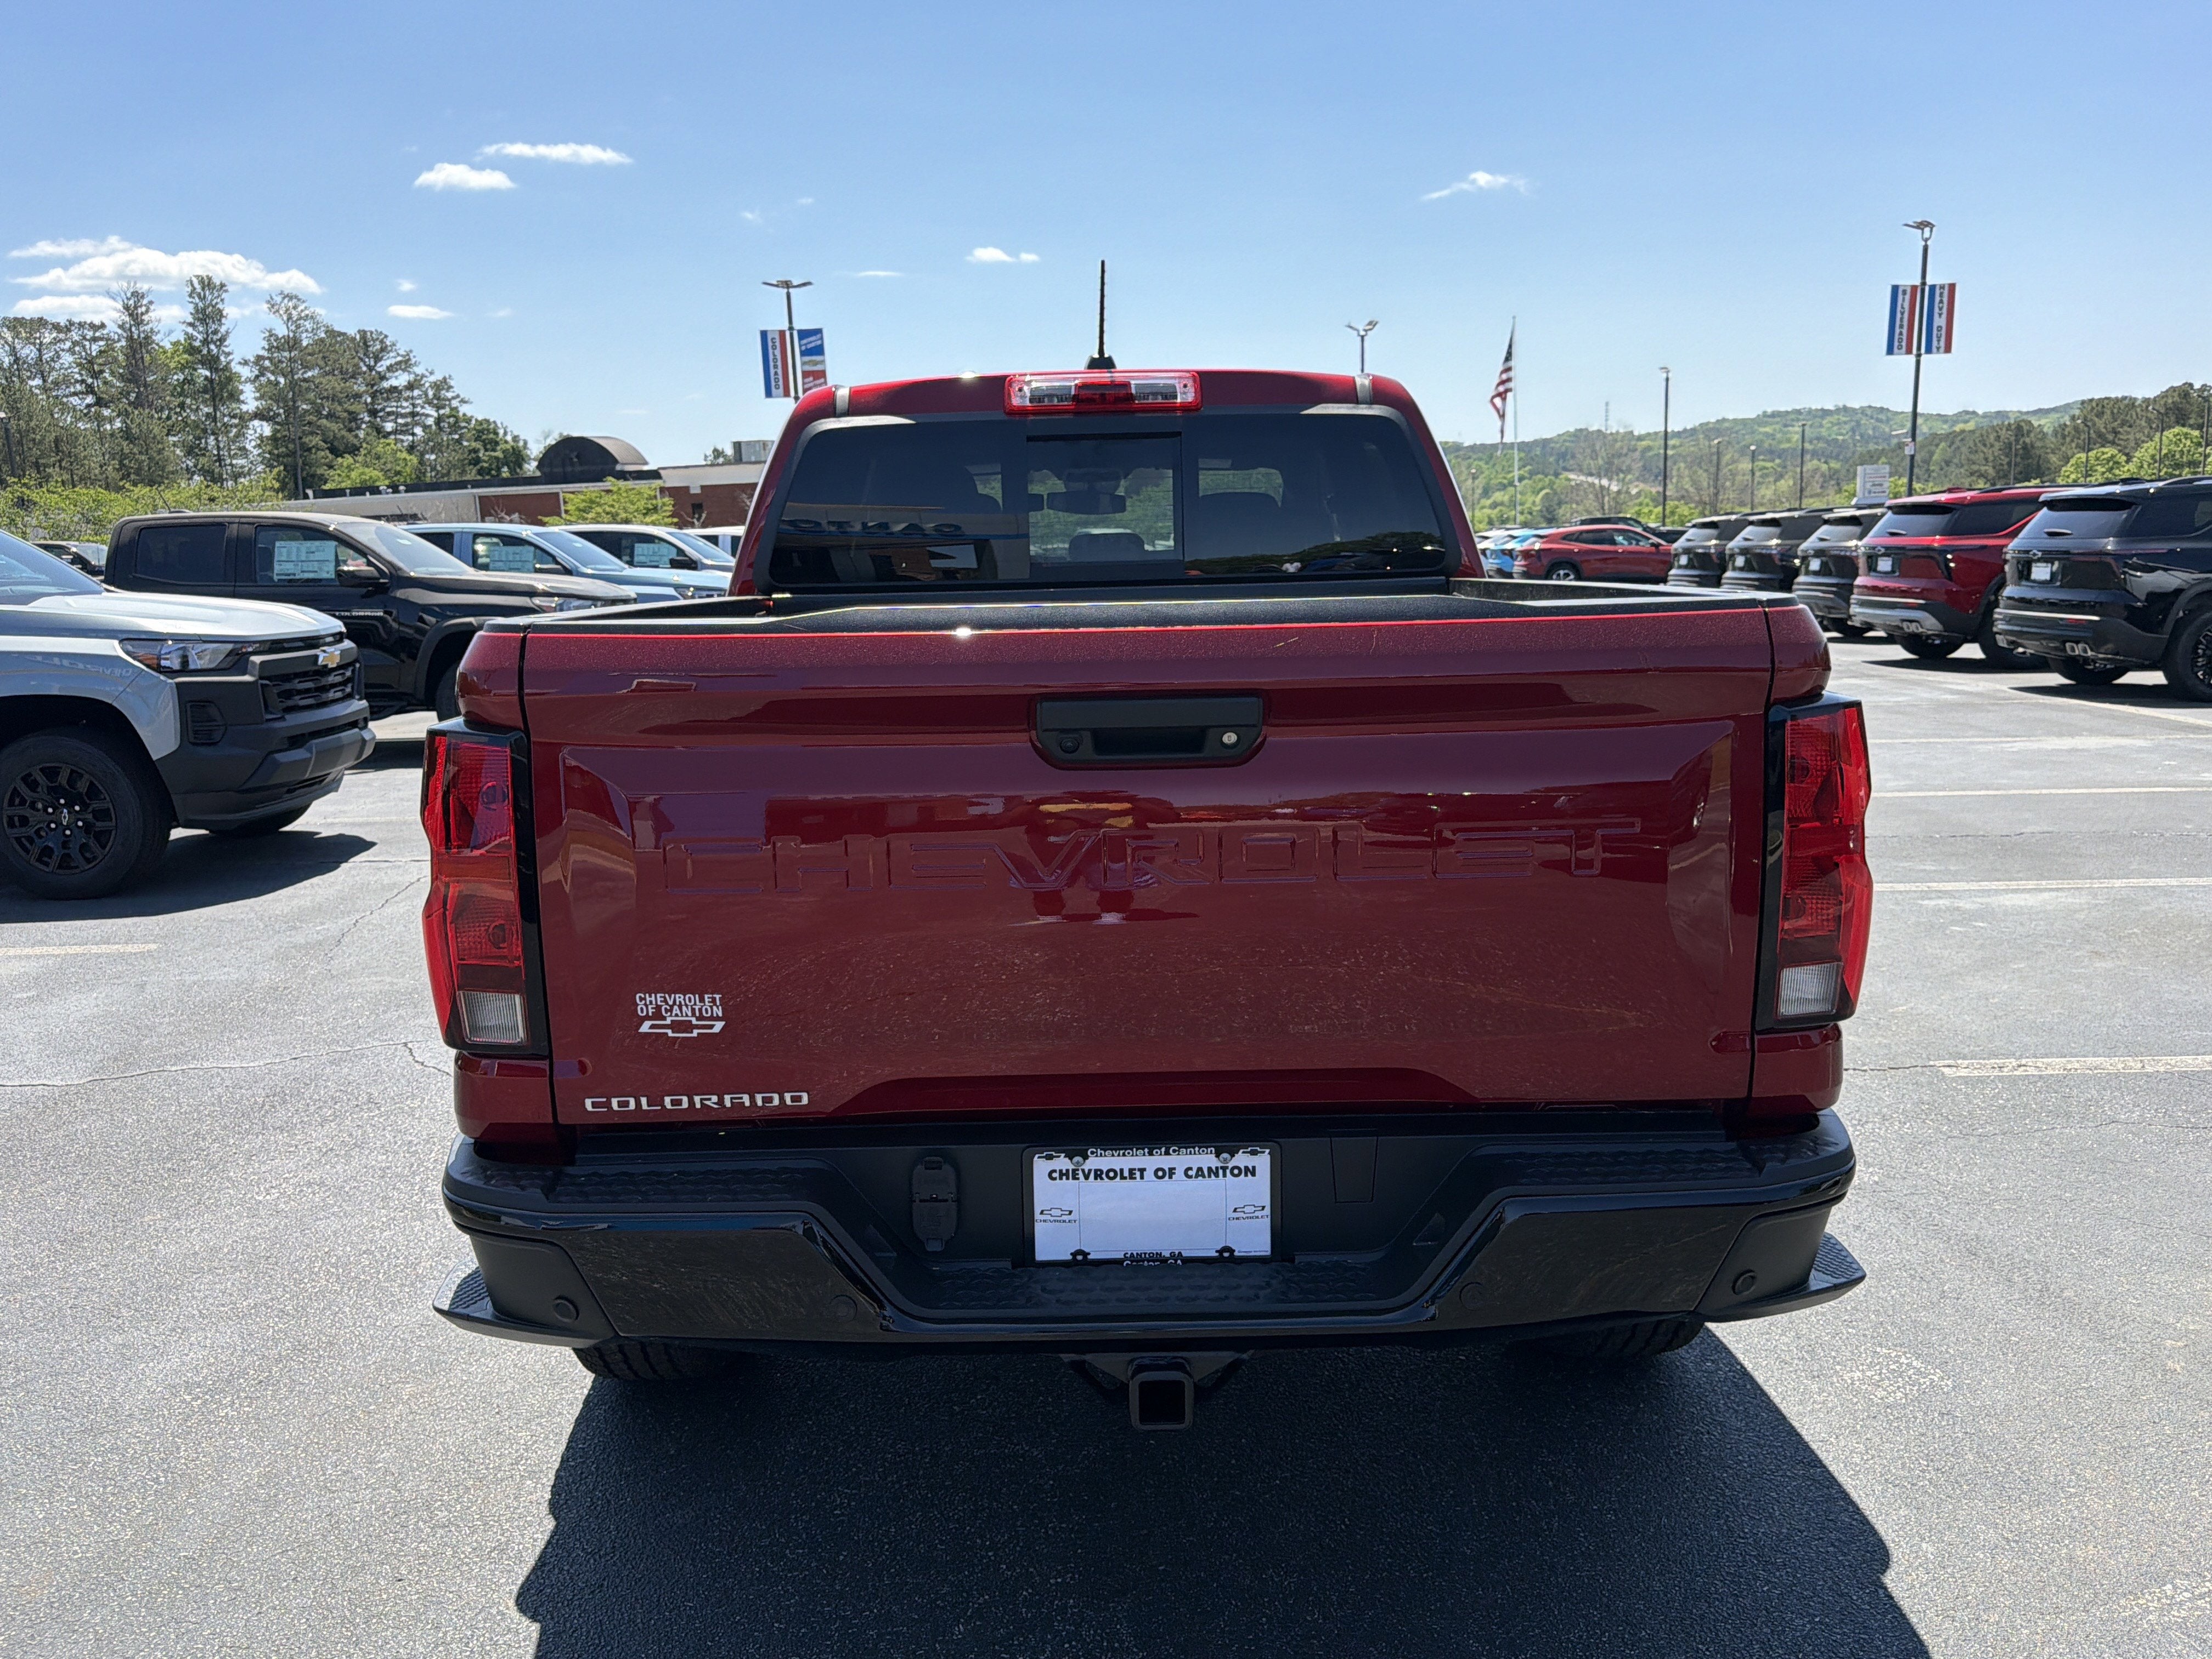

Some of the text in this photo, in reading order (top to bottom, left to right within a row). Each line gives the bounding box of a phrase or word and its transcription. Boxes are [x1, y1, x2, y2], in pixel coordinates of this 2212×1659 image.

[1937, 285, 1945, 319] HEAVY
[1897, 289, 1908, 350] SILVERADO
[771, 337, 781, 390] COLORADO
[662, 817, 1641, 895] CHEVROLET
[636, 994, 722, 1006] CHEVROLET
[637, 1005, 723, 1017] OF CANTON
[585, 1092, 809, 1111] COLORADO
[1088, 1147, 1215, 1157] Chevrolet of Canton
[1048, 1165, 1256, 1181] CHEVROLET OF CANTON
